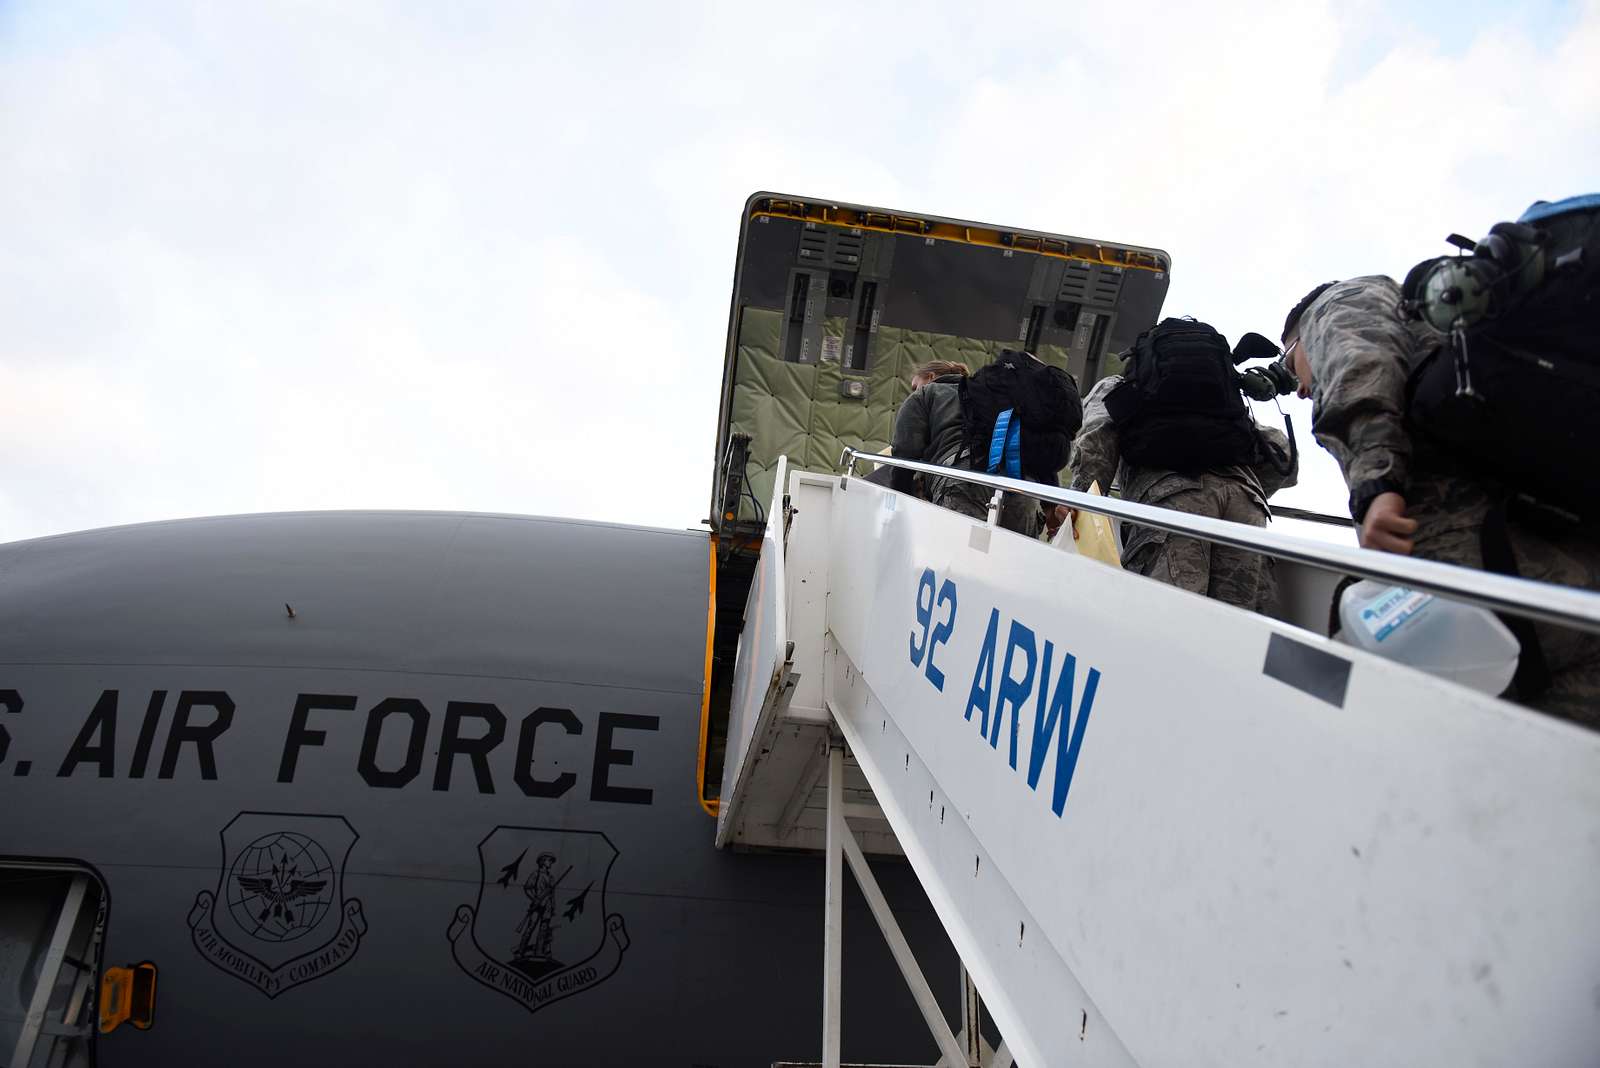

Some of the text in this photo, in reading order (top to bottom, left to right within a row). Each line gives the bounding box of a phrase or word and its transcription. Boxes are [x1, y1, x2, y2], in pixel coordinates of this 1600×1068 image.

[910, 569, 1101, 818] 92 ARW
[56, 689, 236, 780] AIR
[277, 693, 660, 805] FORCE
[197, 927, 356, 991] AIR MOBILITY COMMAND
[474, 961, 598, 1004] AIR NATIONAL GUARD
